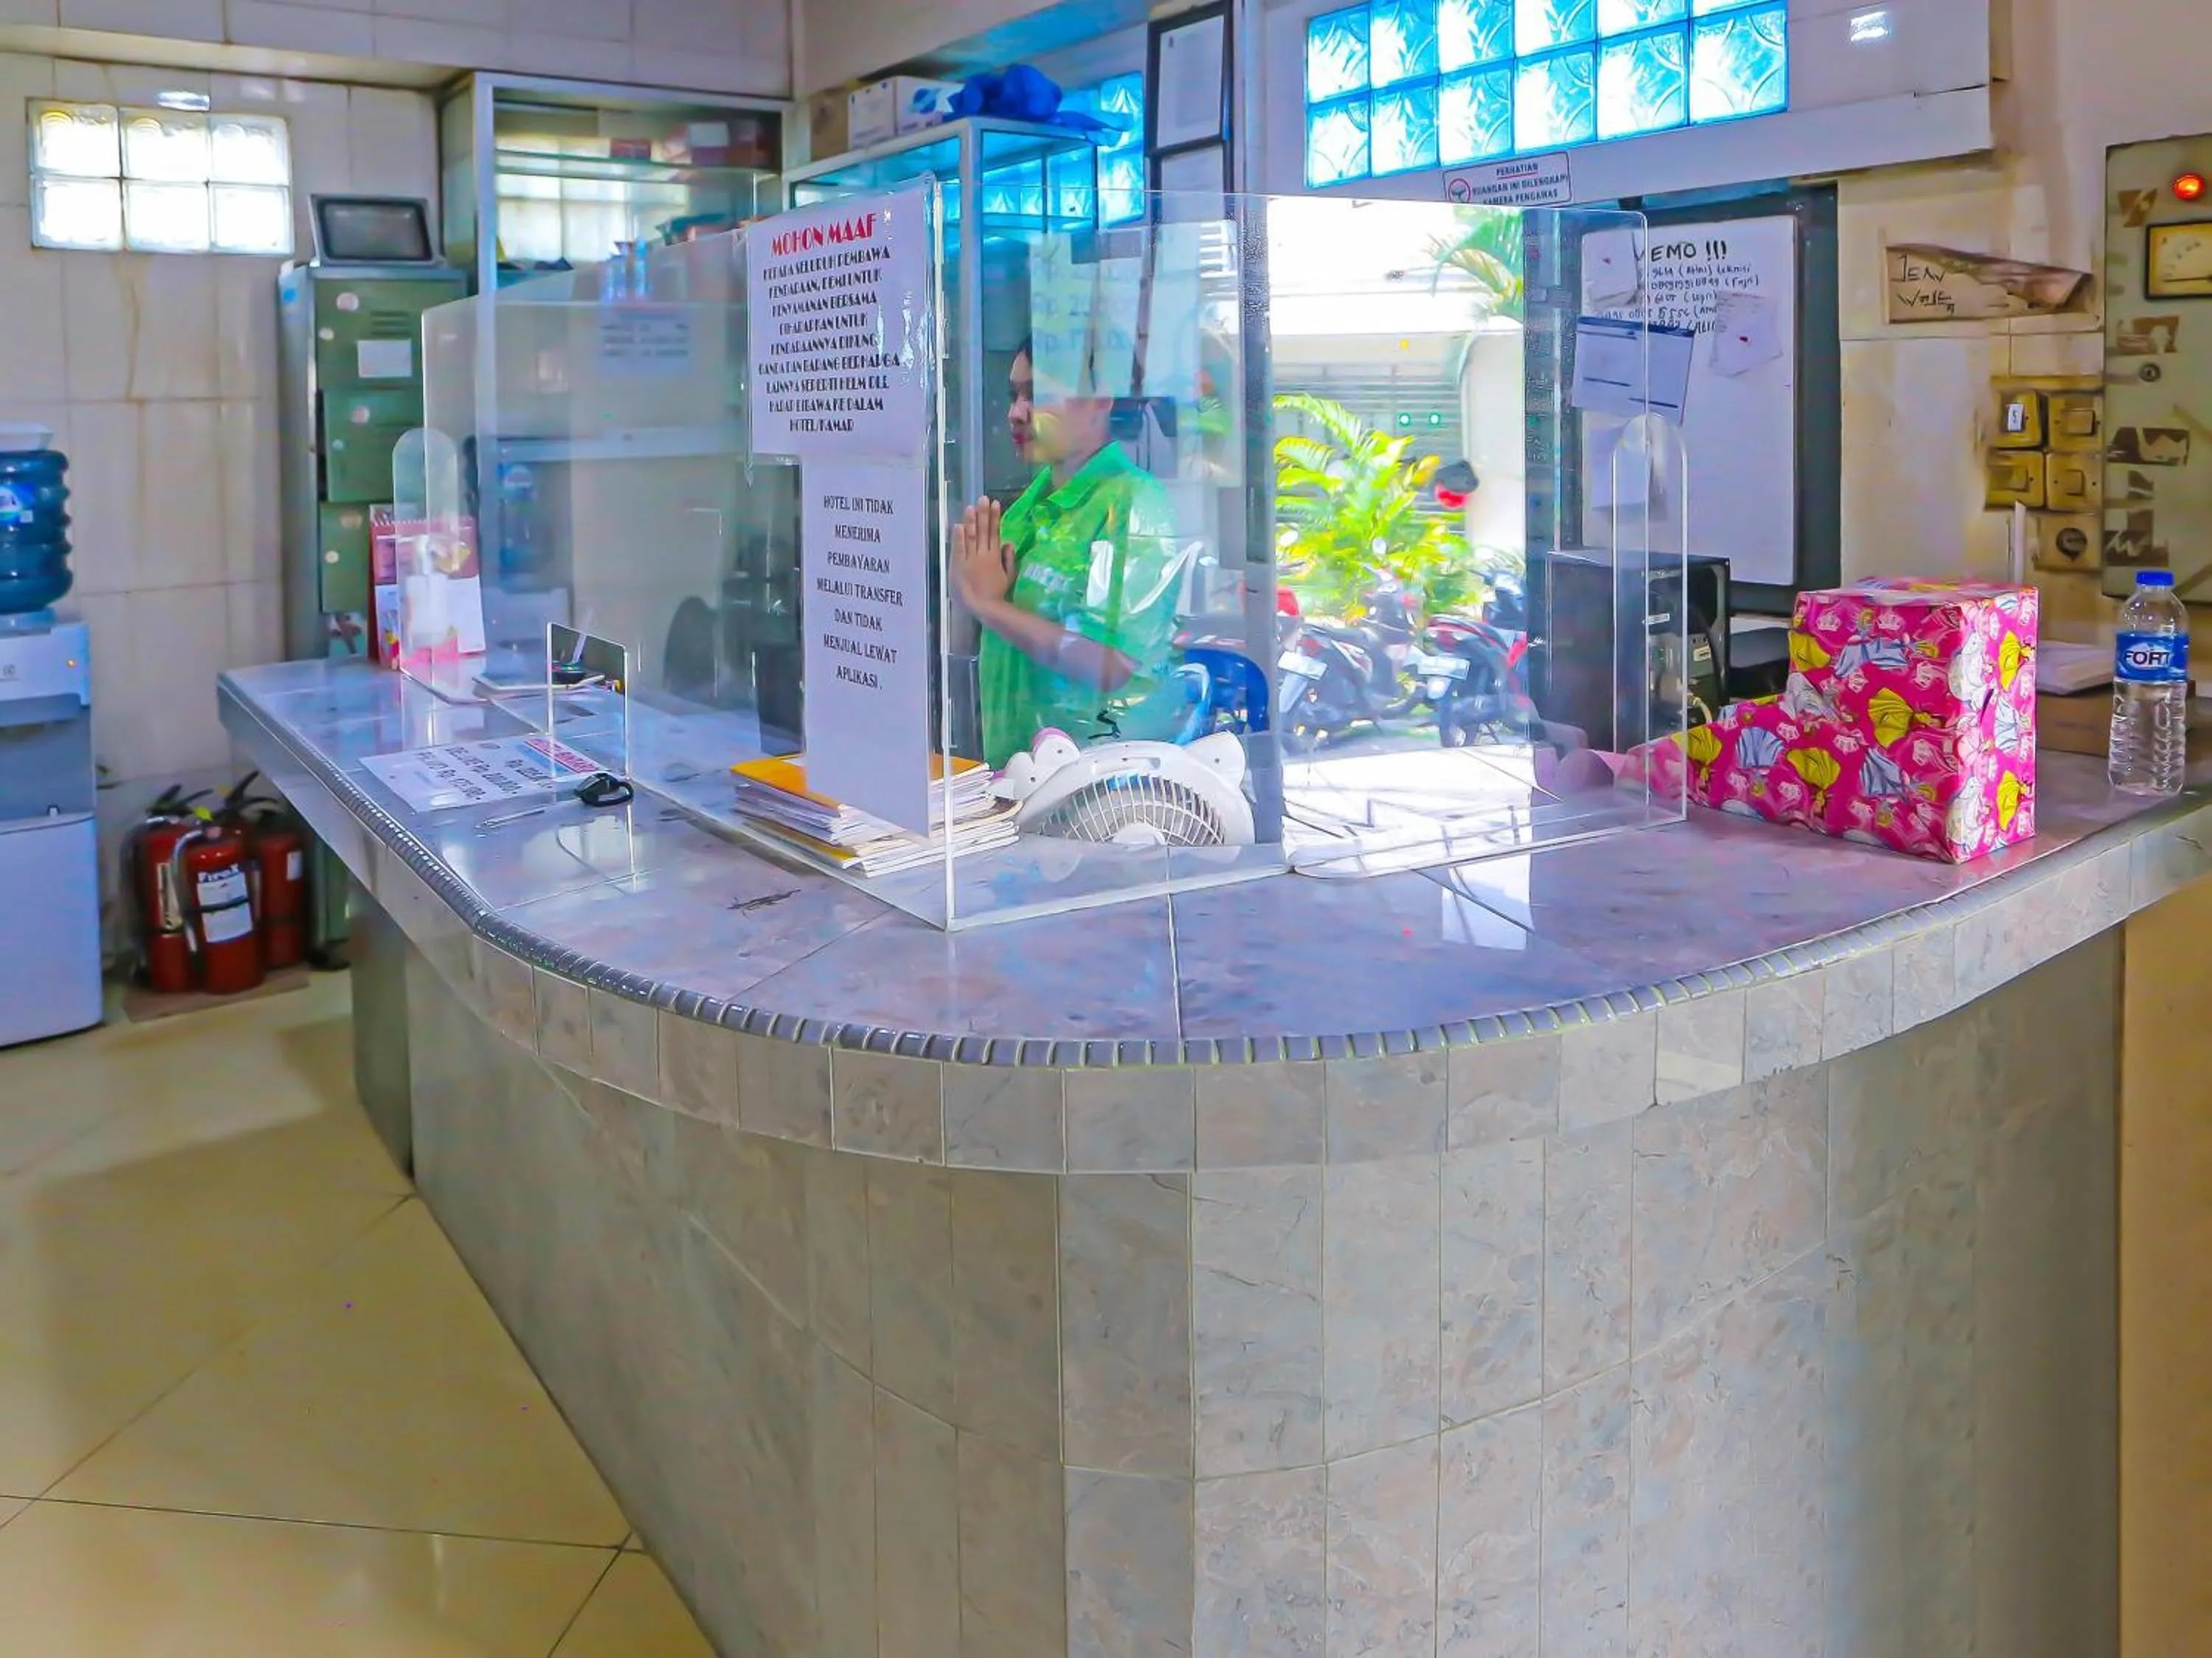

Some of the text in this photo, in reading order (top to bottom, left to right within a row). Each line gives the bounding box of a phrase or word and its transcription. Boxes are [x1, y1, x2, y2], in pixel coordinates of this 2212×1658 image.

[1496, 162, 1539, 176] PERHATIAN
[1515, 189, 1558, 202] PENGAWAS
[771, 213, 876, 256] MOHON MAAF
[847, 397, 884, 411] DALAM
[824, 495, 894, 515] HOTEL INI TIDAK
[835, 524, 881, 544] MENERIMA
[827, 551, 890, 575] PEMBAYARAN
[816, 577, 903, 606] MELALUI TRANSFER
[835, 608, 883, 632] DAN TIDAK
[824, 634, 897, 664] MENJUAL LEWAT
